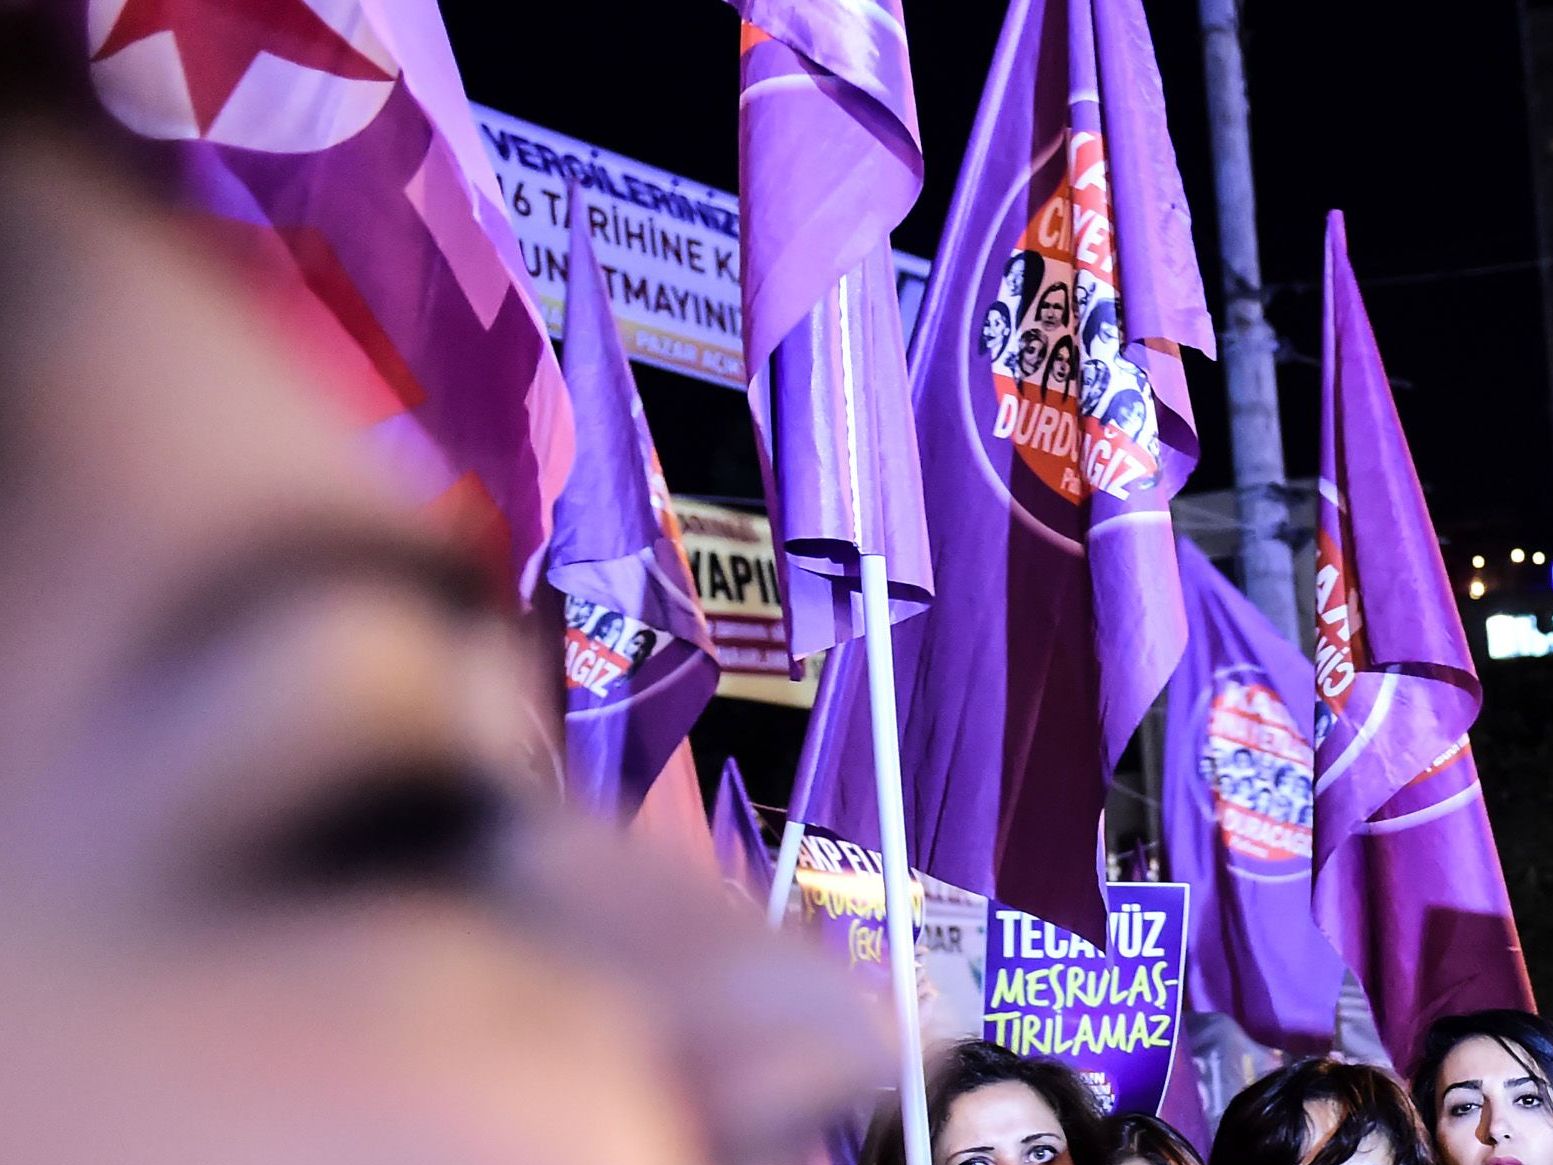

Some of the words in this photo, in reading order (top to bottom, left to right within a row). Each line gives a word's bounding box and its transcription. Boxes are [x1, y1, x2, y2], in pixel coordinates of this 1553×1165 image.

[541, 189, 704, 275] TRİHİNE
[518, 238, 741, 336] UNTMAYINI
[983, 1010, 1172, 1056] TIRILAMAZ
